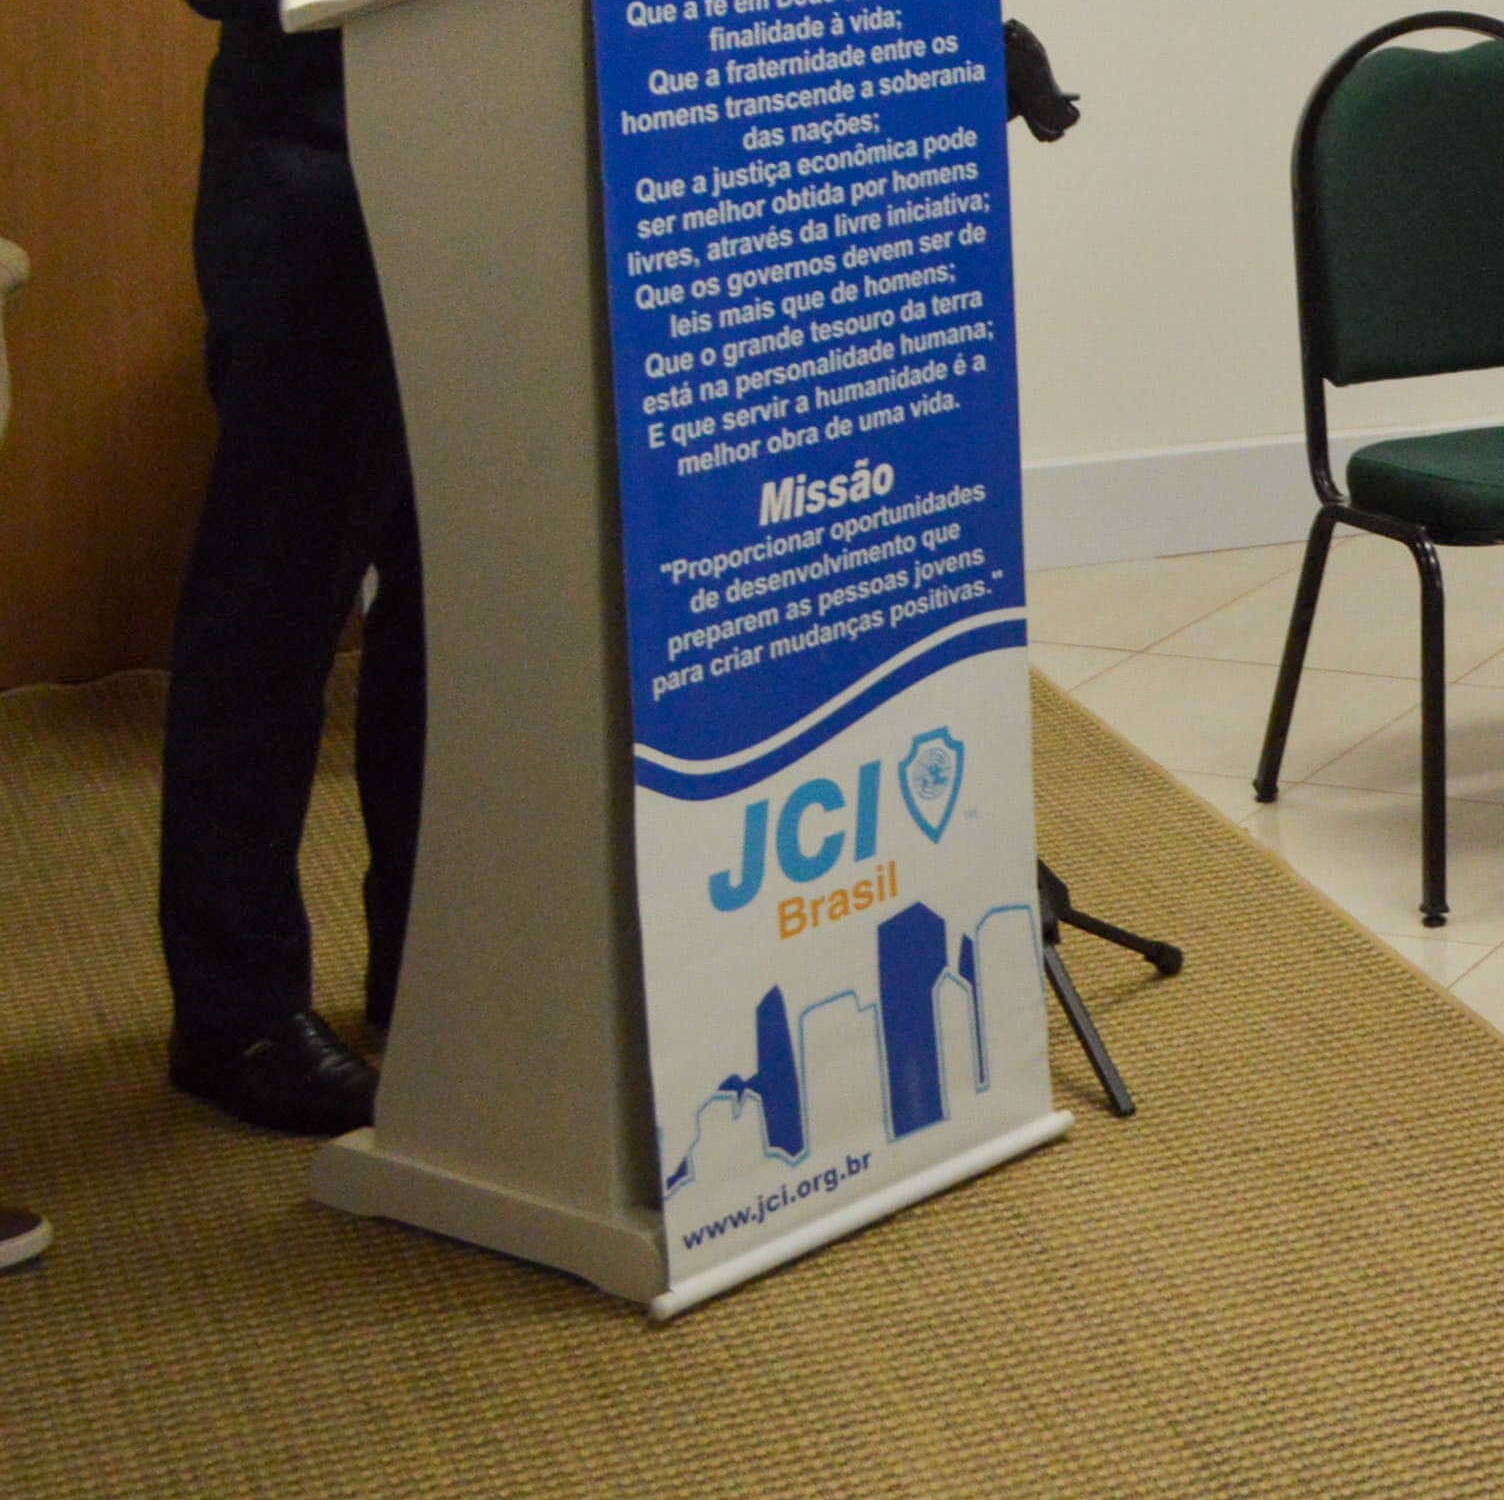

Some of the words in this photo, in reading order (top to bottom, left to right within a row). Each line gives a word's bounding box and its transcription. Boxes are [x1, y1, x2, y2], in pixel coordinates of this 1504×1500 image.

[626, 0, 677, 27] Que
[682, 0, 699, 21] a
[708, 15, 825, 52] finalidade
[830, 11, 845, 36] à
[849, 5, 902, 33] vida;
[621, 102, 720, 135] homens
[724, 79, 856, 119] transcende
[860, 80, 874, 99] a
[878, 59, 986, 96] soberania
[648, 68, 699, 96] Que
[704, 67, 721, 88] a
[725, 43, 866, 85] fraternidade
[870, 38, 927, 64] entre
[931, 34, 959, 55] os
[635, 177, 686, 204] Que
[691, 174, 707, 194] a
[711, 159, 792, 198] justiça
[796, 138, 918, 176] econômica
[923, 126, 978, 160] pode
[742, 125, 785, 151] das
[790, 112, 880, 144] nações;
[627, 247, 700, 277] livres,
[706, 225, 794, 262] através
[799, 219, 829, 244] da
[834, 212, 882, 237] livre
[886, 192, 990, 227] iniciativa;
[637, 214, 677, 239] ser
[682, 198, 766, 231] melhor
[771, 182, 845, 215] obtida
[850, 177, 888, 207] por
[892, 161, 979, 193] homens
[635, 283, 685, 310] Que
[690, 276, 721, 299] os
[726, 254, 837, 298] governos
[842, 238, 914, 269] devem
[918, 230, 954, 254] ser
[958, 222, 987, 246] de
[670, 310, 713, 338] leis
[718, 297, 776, 328] mais
[781, 290, 825, 319] que
[830, 280, 859, 305] de
[863, 263, 955, 298] homens;
[642, 381, 693, 415] está
[699, 378, 729, 402] na
[735, 339, 895, 400] personalidade
[900, 320, 994, 355] humana;
[644, 351, 694, 379] Que
[700, 347, 717, 367] o
[722, 325, 805, 368] grande
[809, 309, 896, 343] tesouro
[899, 298, 927, 323] da
[931, 290, 983, 317] terra
[647, 422, 665, 449] E
[671, 416, 716, 447] que
[721, 395, 790, 431] servir
[794, 395, 810, 414] a
[814, 359, 948, 409] humanidade
[953, 352, 967, 376] é
[972, 354, 986, 372] a
[677, 439, 761, 476] melhor
[766, 426, 819, 454] obra
[824, 415, 853, 441] de
[858, 405, 905, 432] uma
[909, 390, 961, 418] vida.
[660, 526, 825, 584] "Proporcionar
[830, 484, 986, 543] oportunidades
[758, 457, 895, 527] Missão
[668, 607, 780, 662] preparem
[785, 598, 812, 621] as
[818, 569, 909, 617] pessoas
[913, 548, 985, 589] jovens
[689, 587, 720, 614] de
[725, 535, 917, 603] desenvolvimento
[921, 522, 961, 551] que
[652, 663, 704, 701] para
[709, 644, 764, 677] criar
[769, 609, 885, 659] mudanças
[889, 569, 1003, 628] positivas."
[708, 760, 881, 912] JCI
[777, 860, 898, 940] Brasil
[682, 1152, 872, 1250] www.jci.org.br
